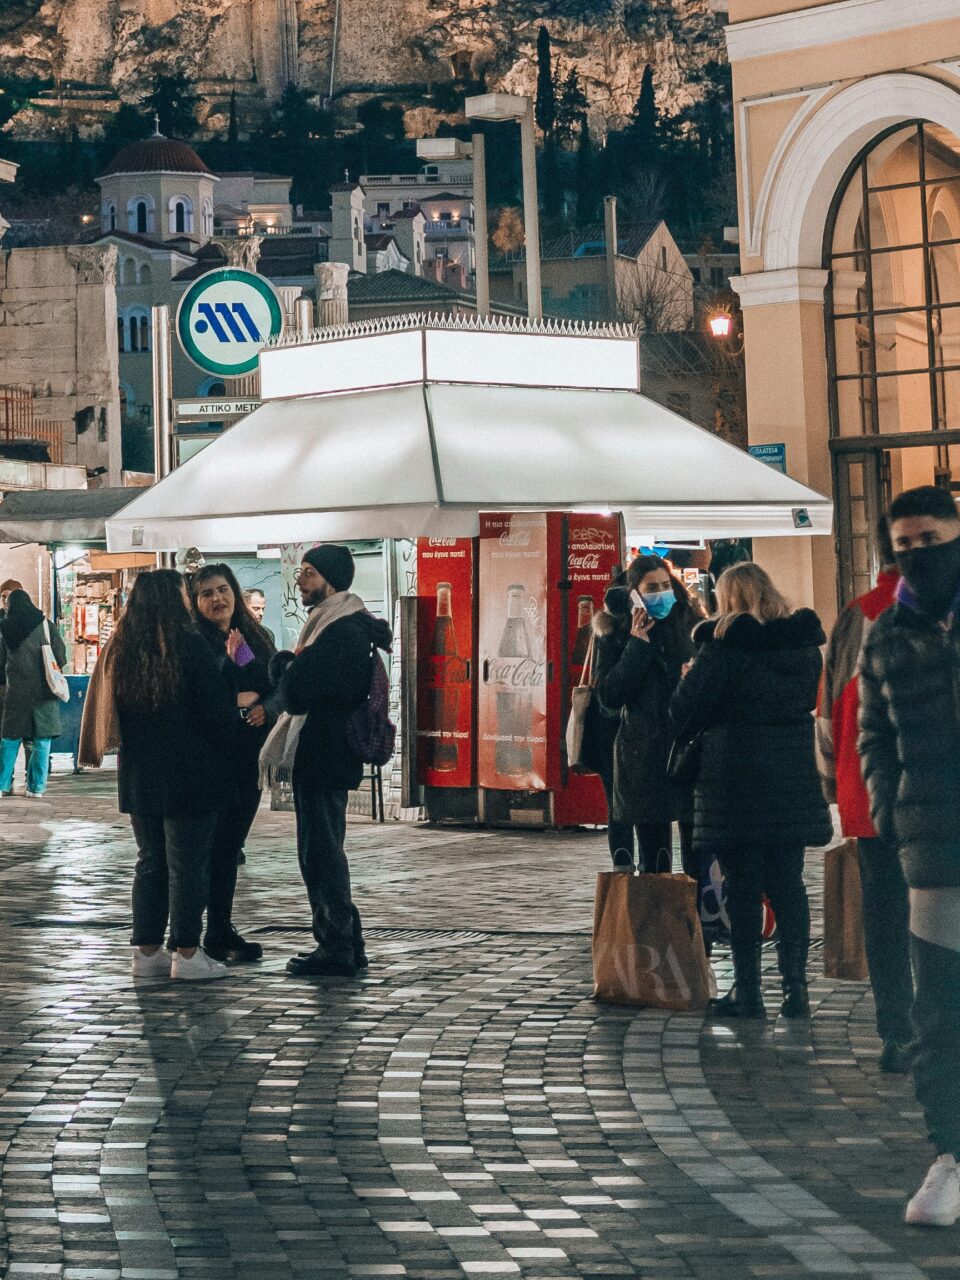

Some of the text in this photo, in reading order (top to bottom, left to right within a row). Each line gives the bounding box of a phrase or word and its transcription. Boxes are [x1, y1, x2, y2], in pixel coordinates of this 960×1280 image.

[199, 403, 260, 413] ΑΤΤΙΚΟ ΜΕΤΡ
[596, 942, 692, 1002] ARA
